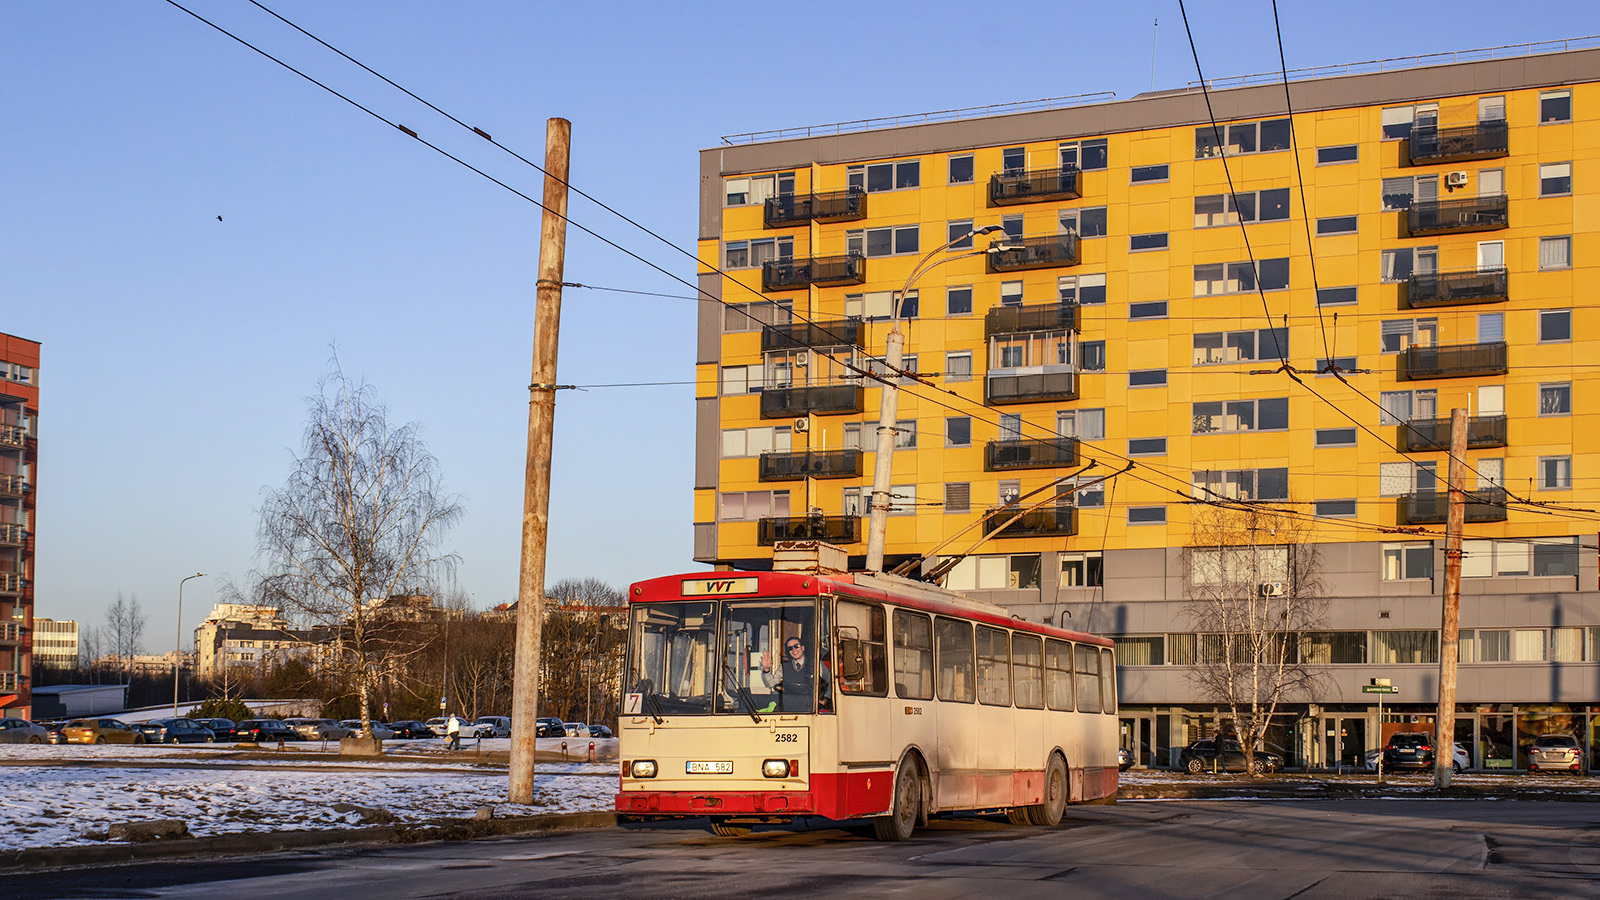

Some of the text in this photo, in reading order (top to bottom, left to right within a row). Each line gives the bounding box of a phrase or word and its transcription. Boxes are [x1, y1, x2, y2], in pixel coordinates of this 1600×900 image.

[707, 581, 735, 592] VVT
[630, 695, 639, 712] 7
[775, 734, 797, 742] 2582
[691, 762, 731, 771] BNA 582
